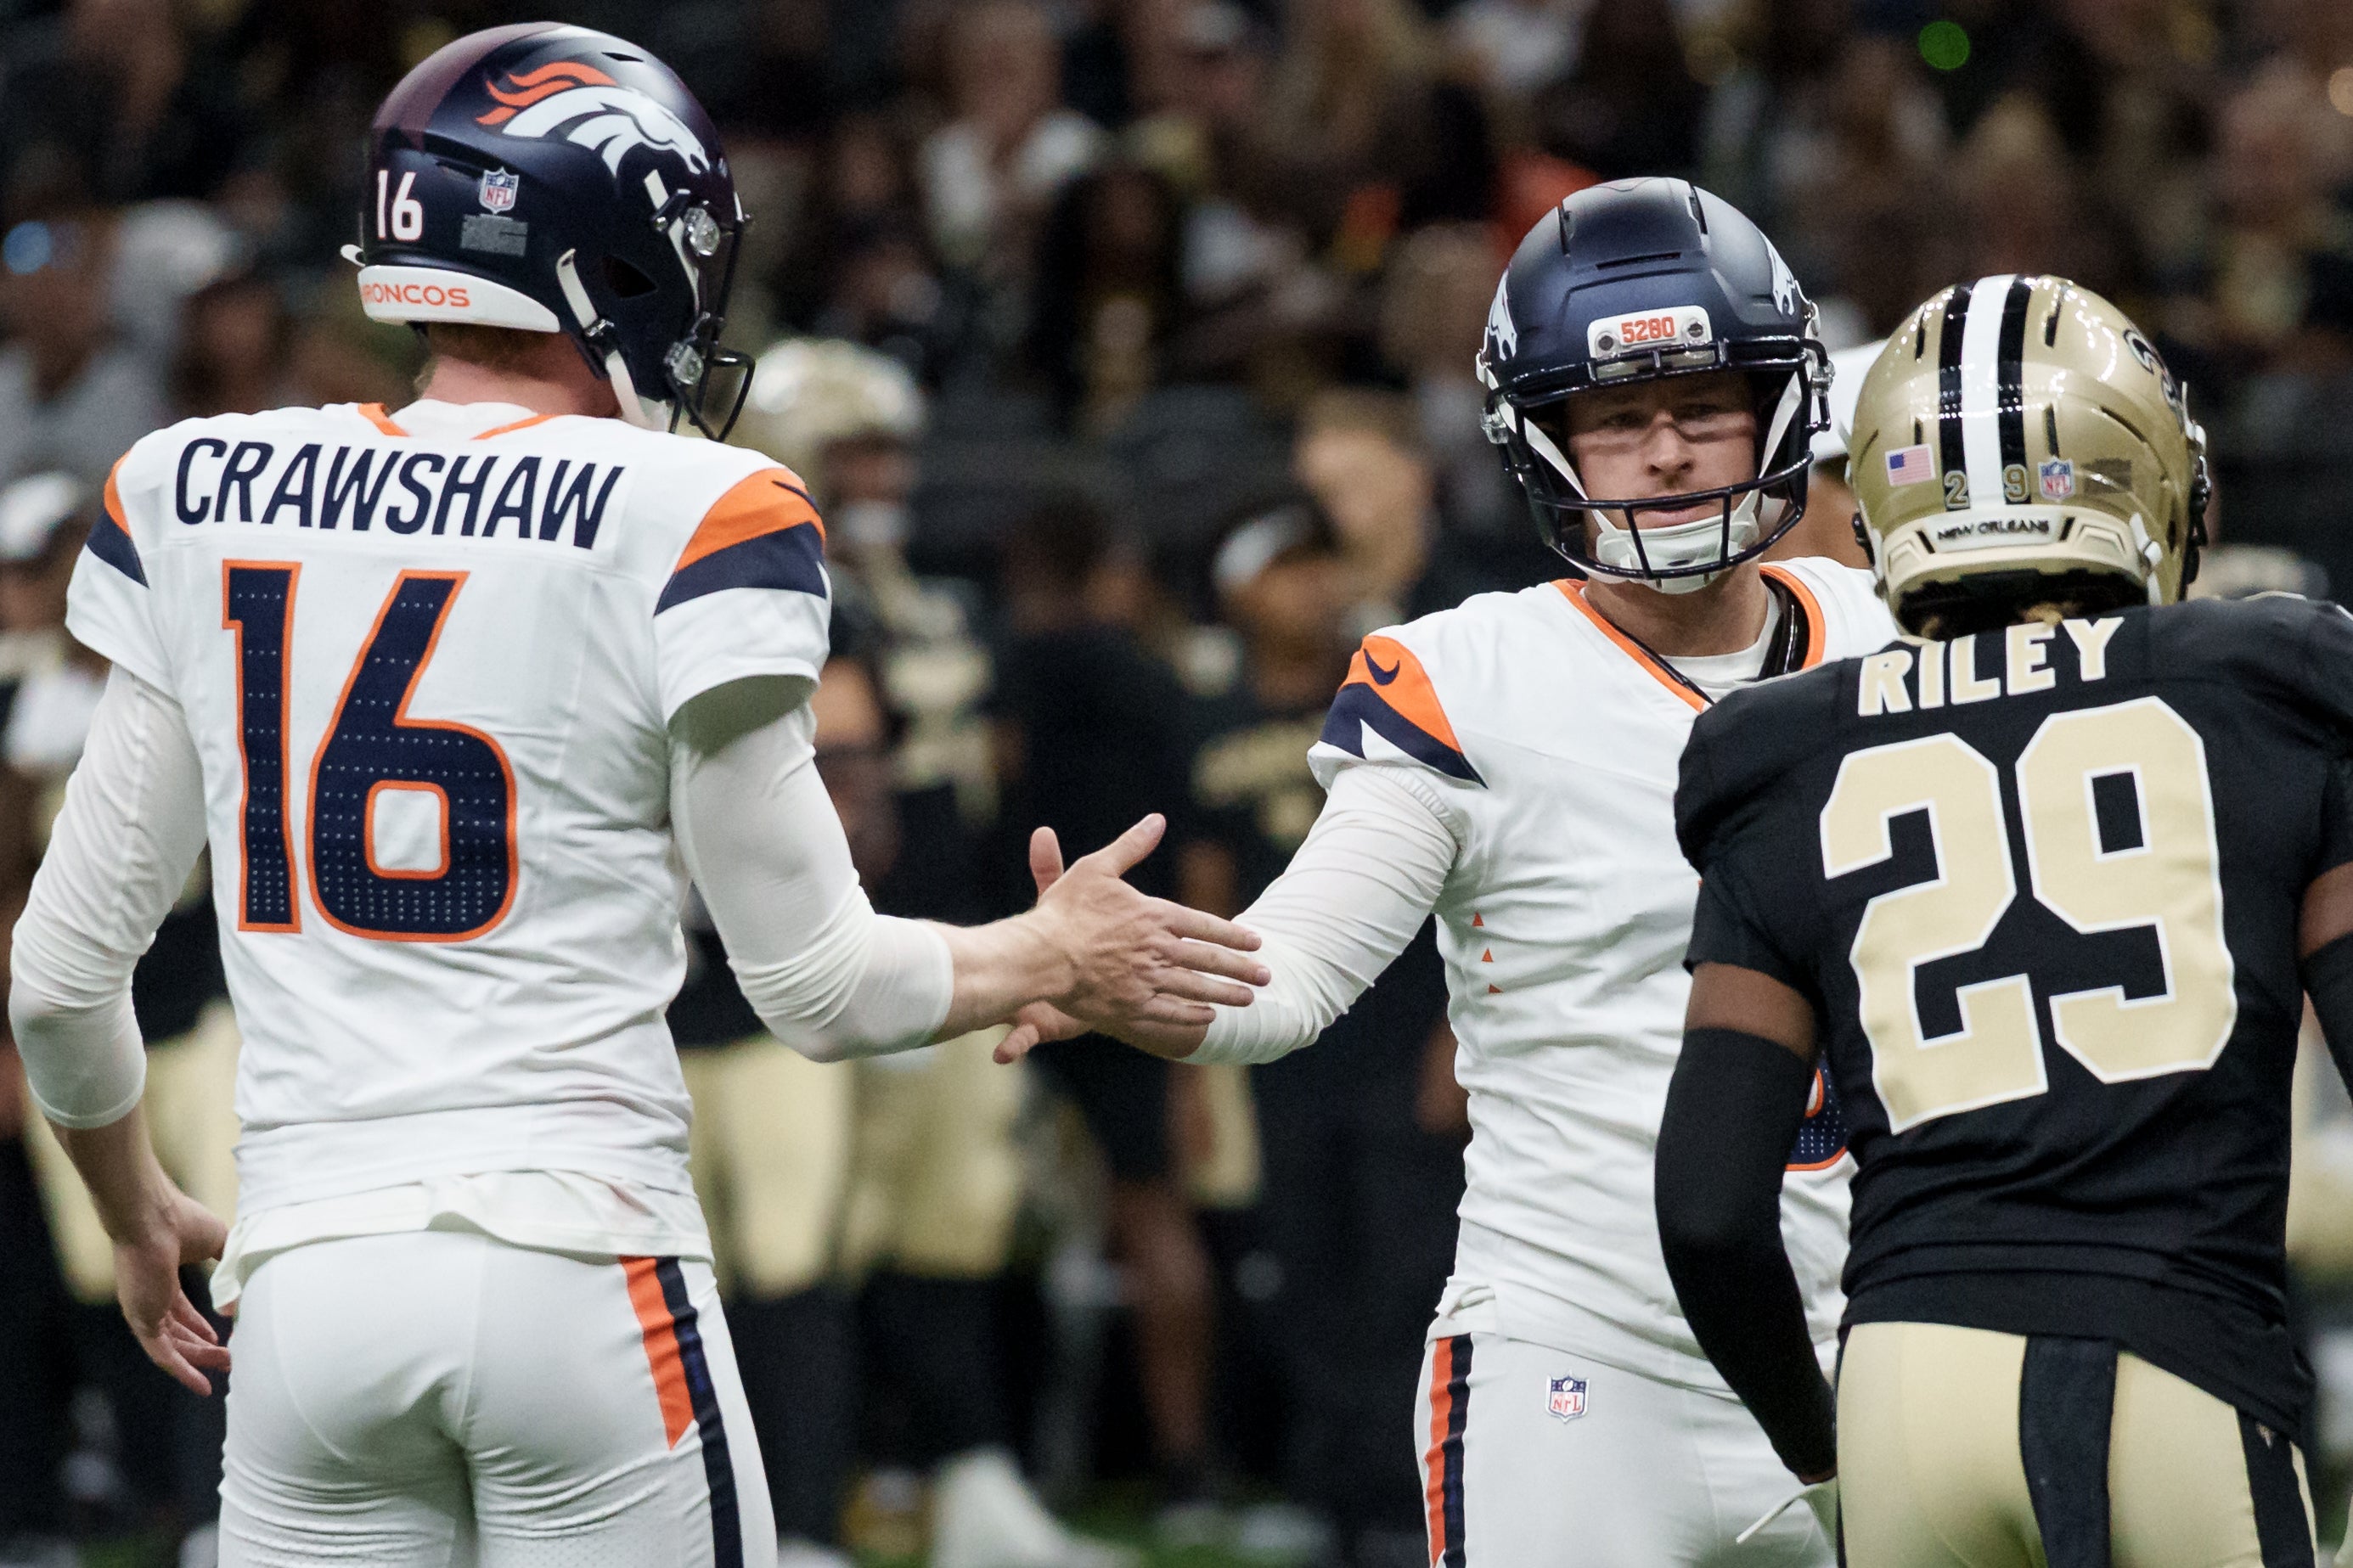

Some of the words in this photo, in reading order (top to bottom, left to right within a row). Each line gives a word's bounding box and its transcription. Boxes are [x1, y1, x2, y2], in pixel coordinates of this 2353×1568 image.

[377, 170, 423, 241] 16
[486, 187, 511, 205] NFL
[360, 283, 470, 306] RONCOS
[1621, 316, 1675, 343] 5280
[175, 437, 625, 549] CRAWSHAW
[2043, 475, 2072, 493] NFL
[1937, 523, 1973, 541] NEW
[1978, 520, 2049, 537] ORLEANS
[1858, 617, 2124, 717] RILEY
[222, 558, 519, 942] 16
[1820, 695, 2238, 1136] 29
[1552, 1393, 1581, 1413] NFL
